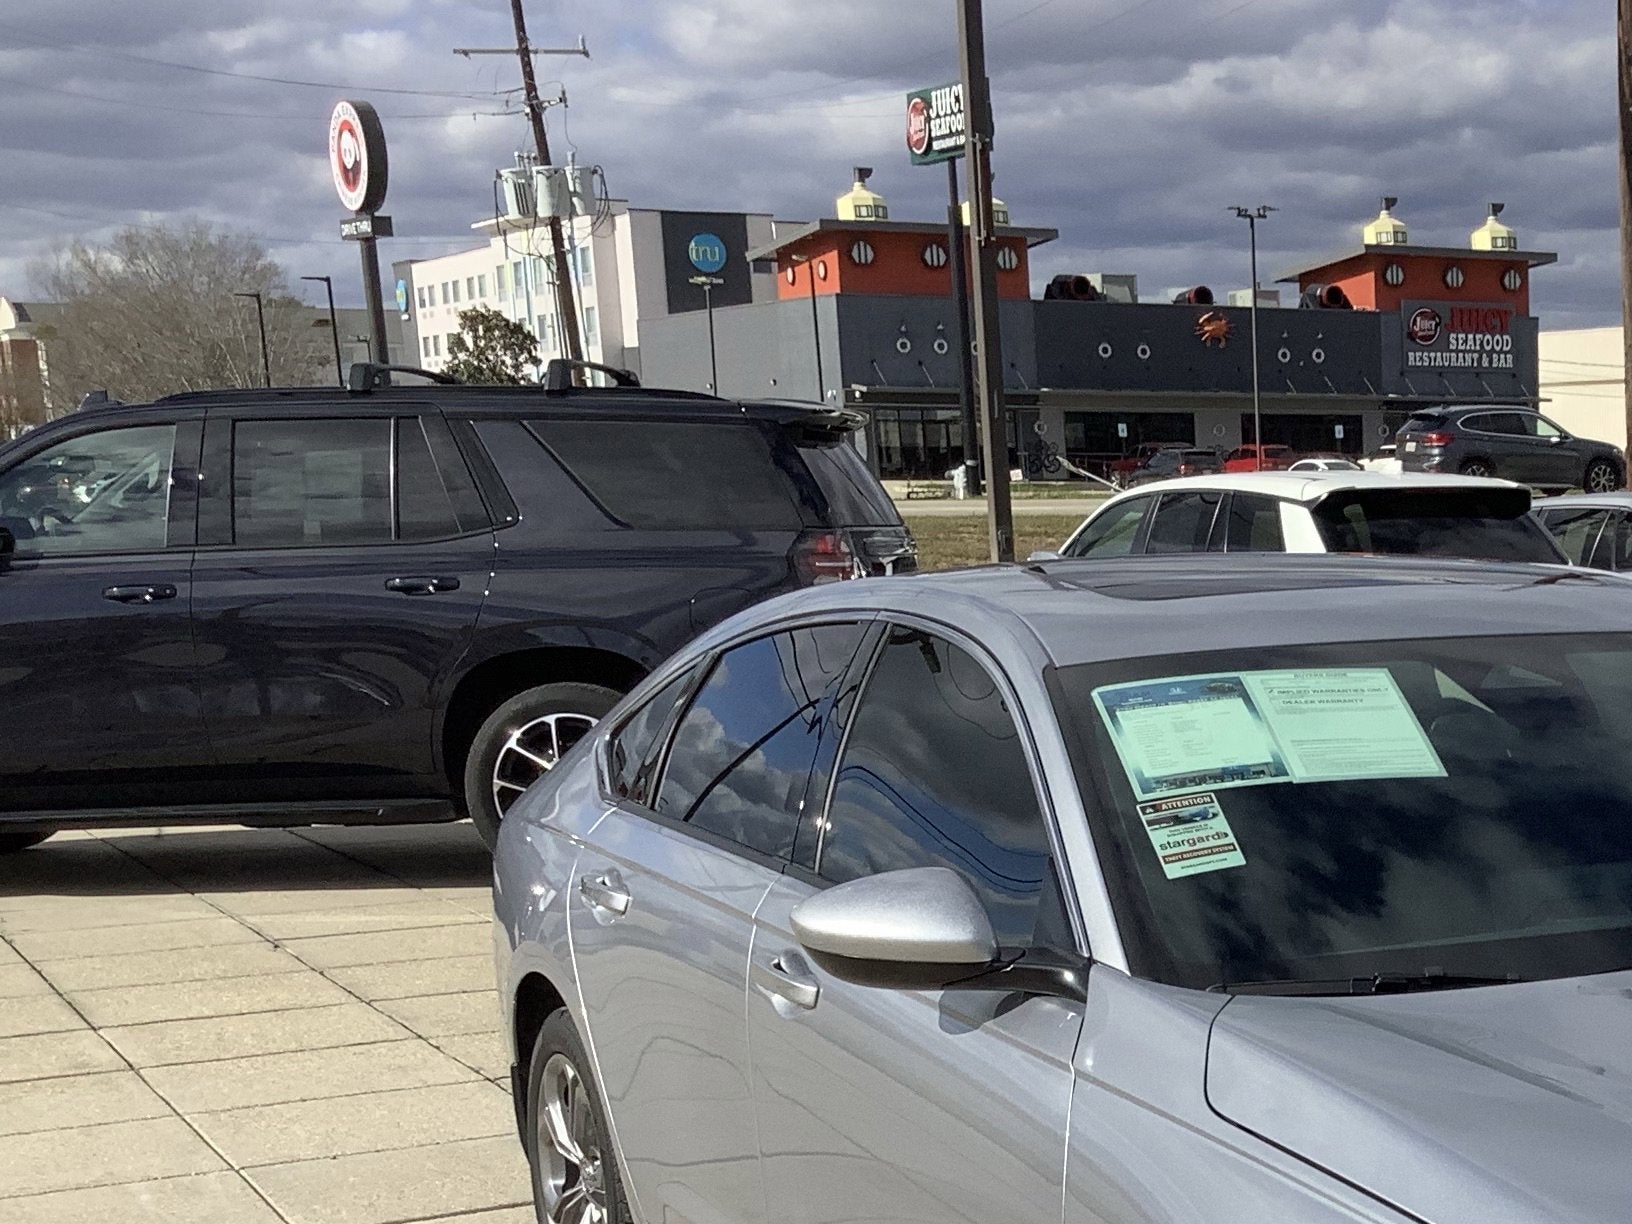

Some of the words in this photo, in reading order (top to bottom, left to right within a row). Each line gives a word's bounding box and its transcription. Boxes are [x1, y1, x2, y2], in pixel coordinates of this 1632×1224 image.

[692, 240, 720, 262] tru
[1445, 307, 1511, 332] JUICY
[1449, 332, 1512, 351] SEAFOOD
[1407, 351, 1480, 367] RESTAURANT
[1481, 353, 1490, 368] &
[1492, 353, 1514, 368] BAR
[1161, 796, 1211, 810] ATTENTION
[1159, 832, 1222, 851] stargard
